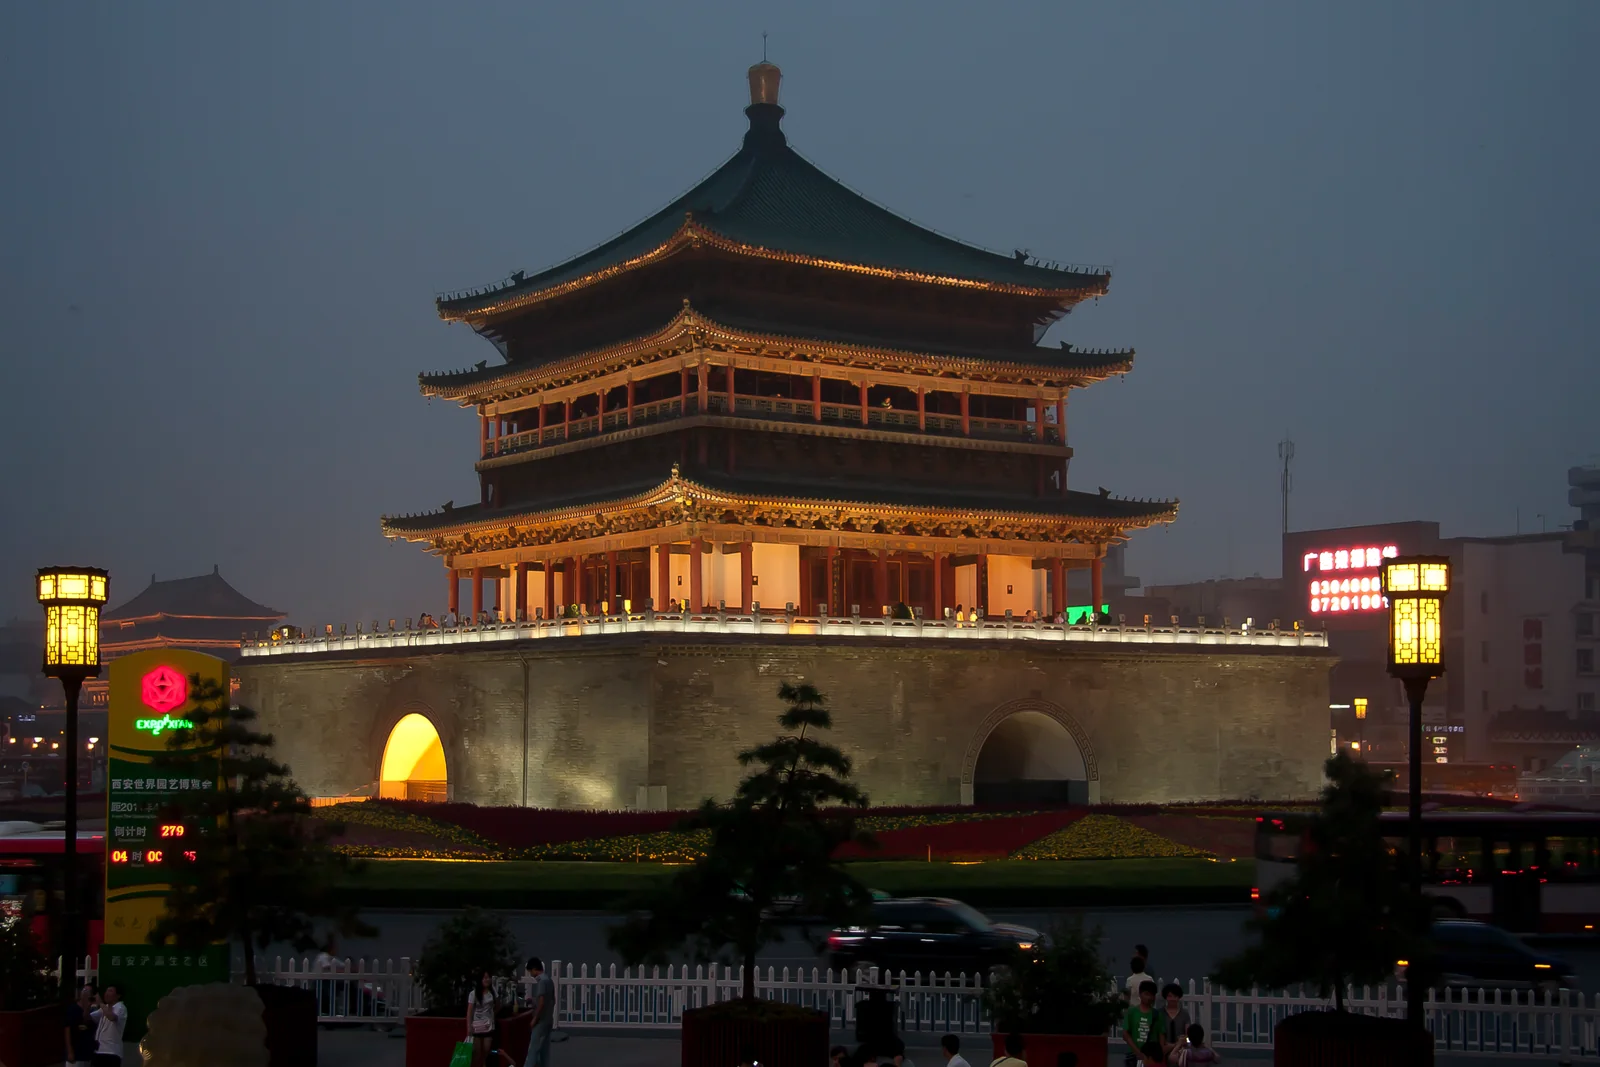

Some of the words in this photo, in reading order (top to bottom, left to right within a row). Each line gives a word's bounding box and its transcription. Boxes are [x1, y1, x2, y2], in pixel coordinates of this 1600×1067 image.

[111, 778, 213, 790] 西安世界园艺博览会
[114, 825, 147, 837] 倒计时
[160, 825, 185, 837] 279
[112, 850, 128, 863] 04
